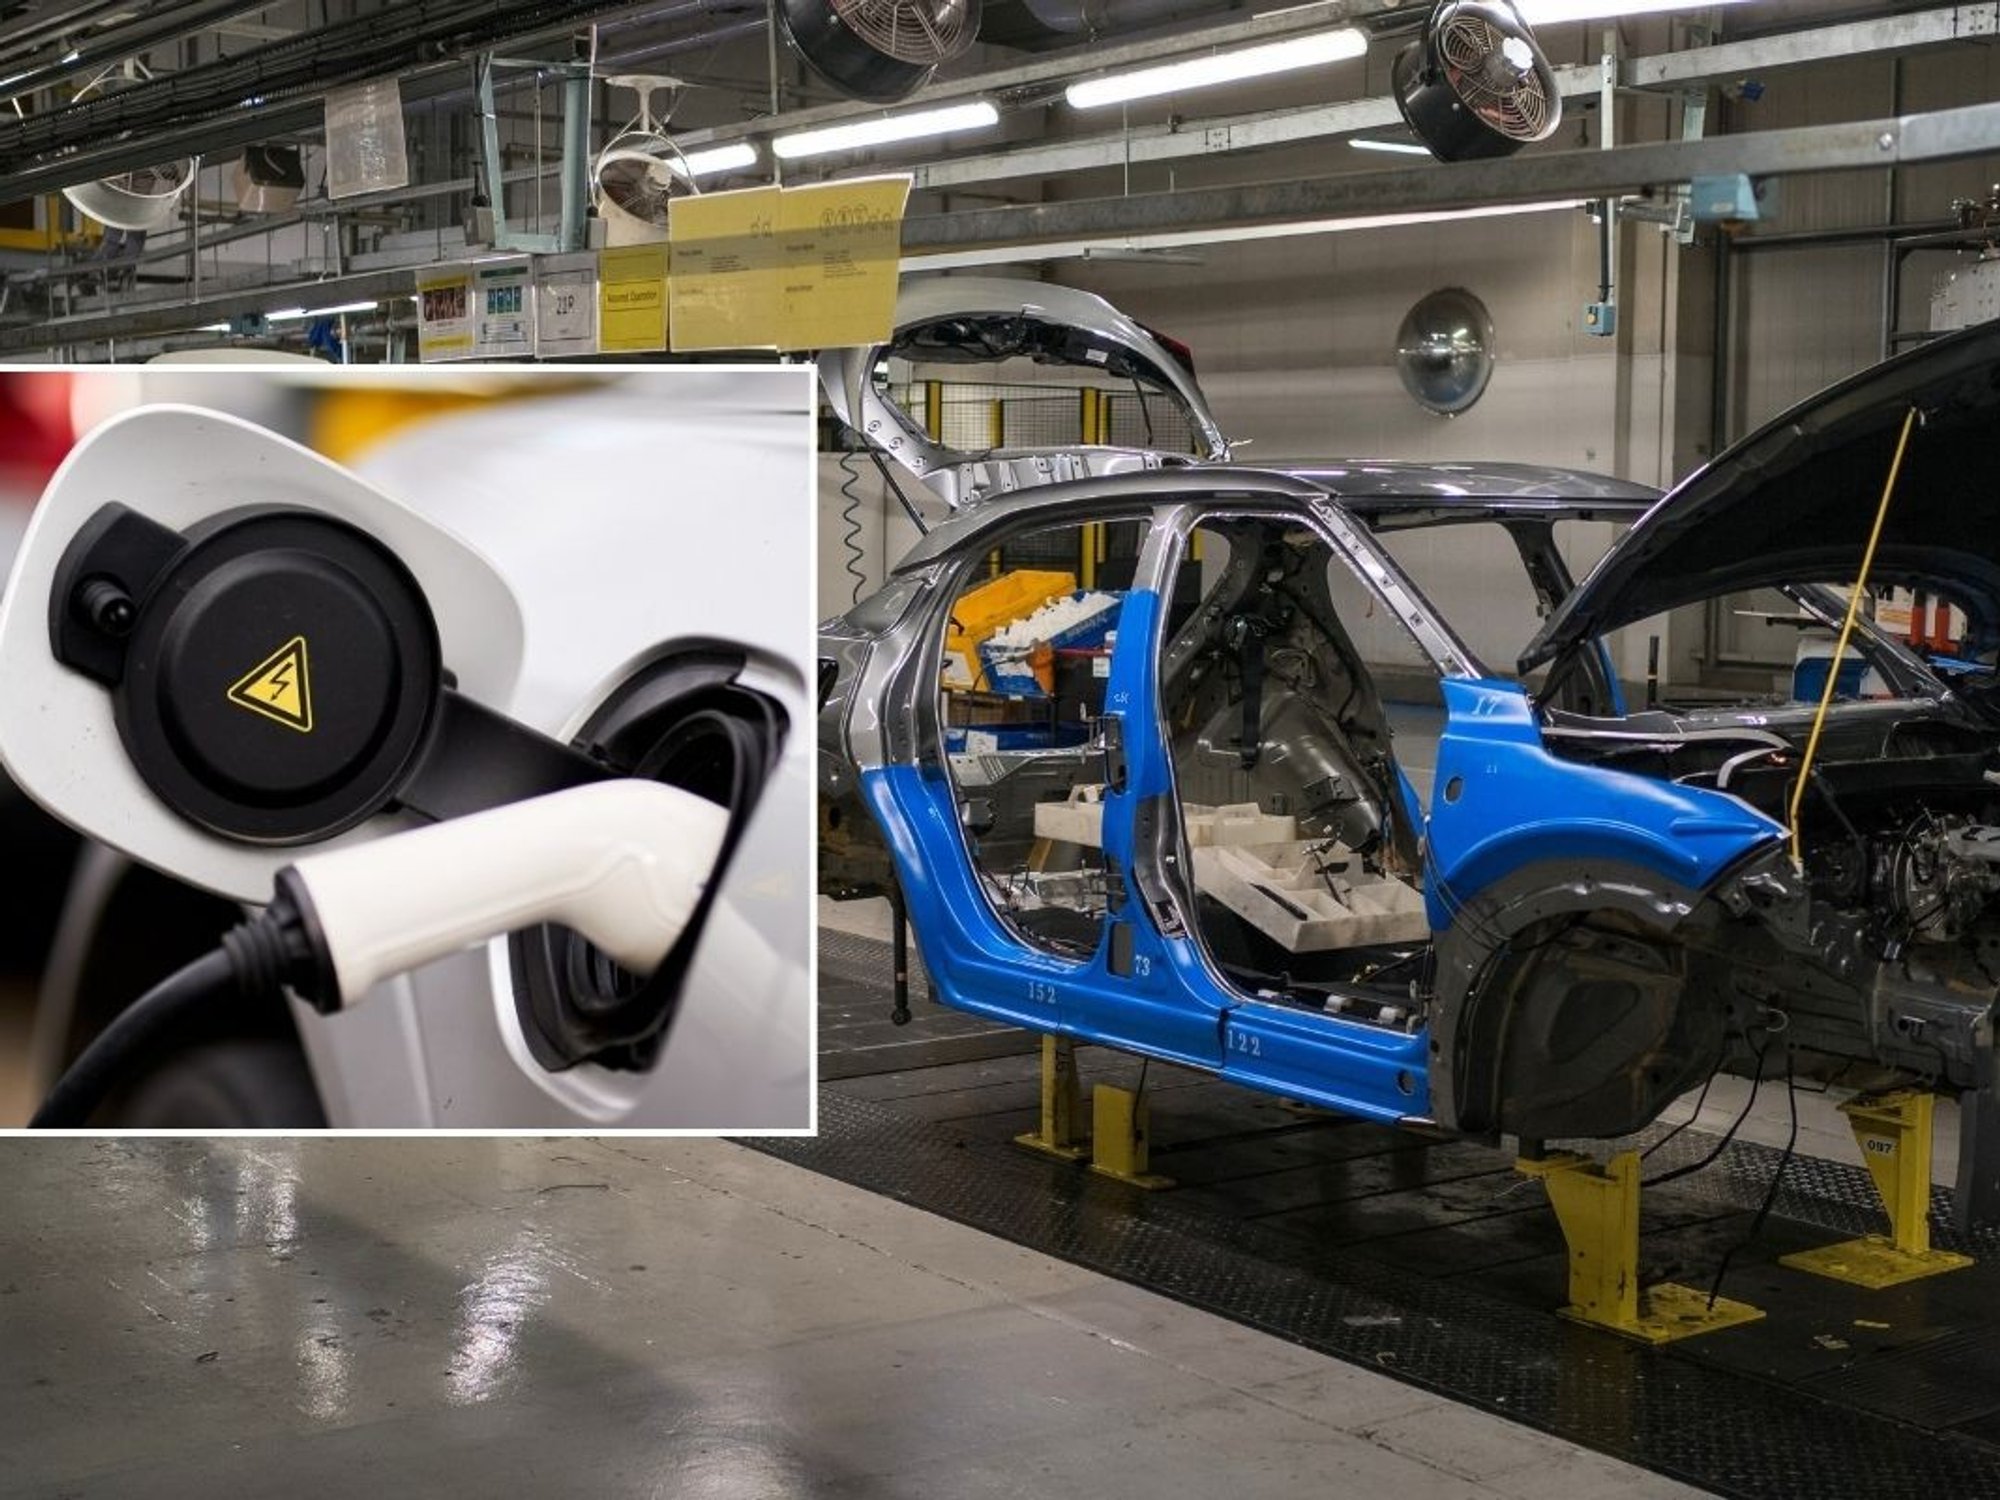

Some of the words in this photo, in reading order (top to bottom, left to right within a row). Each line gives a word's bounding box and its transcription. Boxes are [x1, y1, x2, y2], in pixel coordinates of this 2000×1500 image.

[1135, 954, 1151, 976] 73
[1028, 981, 1056, 1004] 152
[1228, 1030, 1261, 1057] 122
